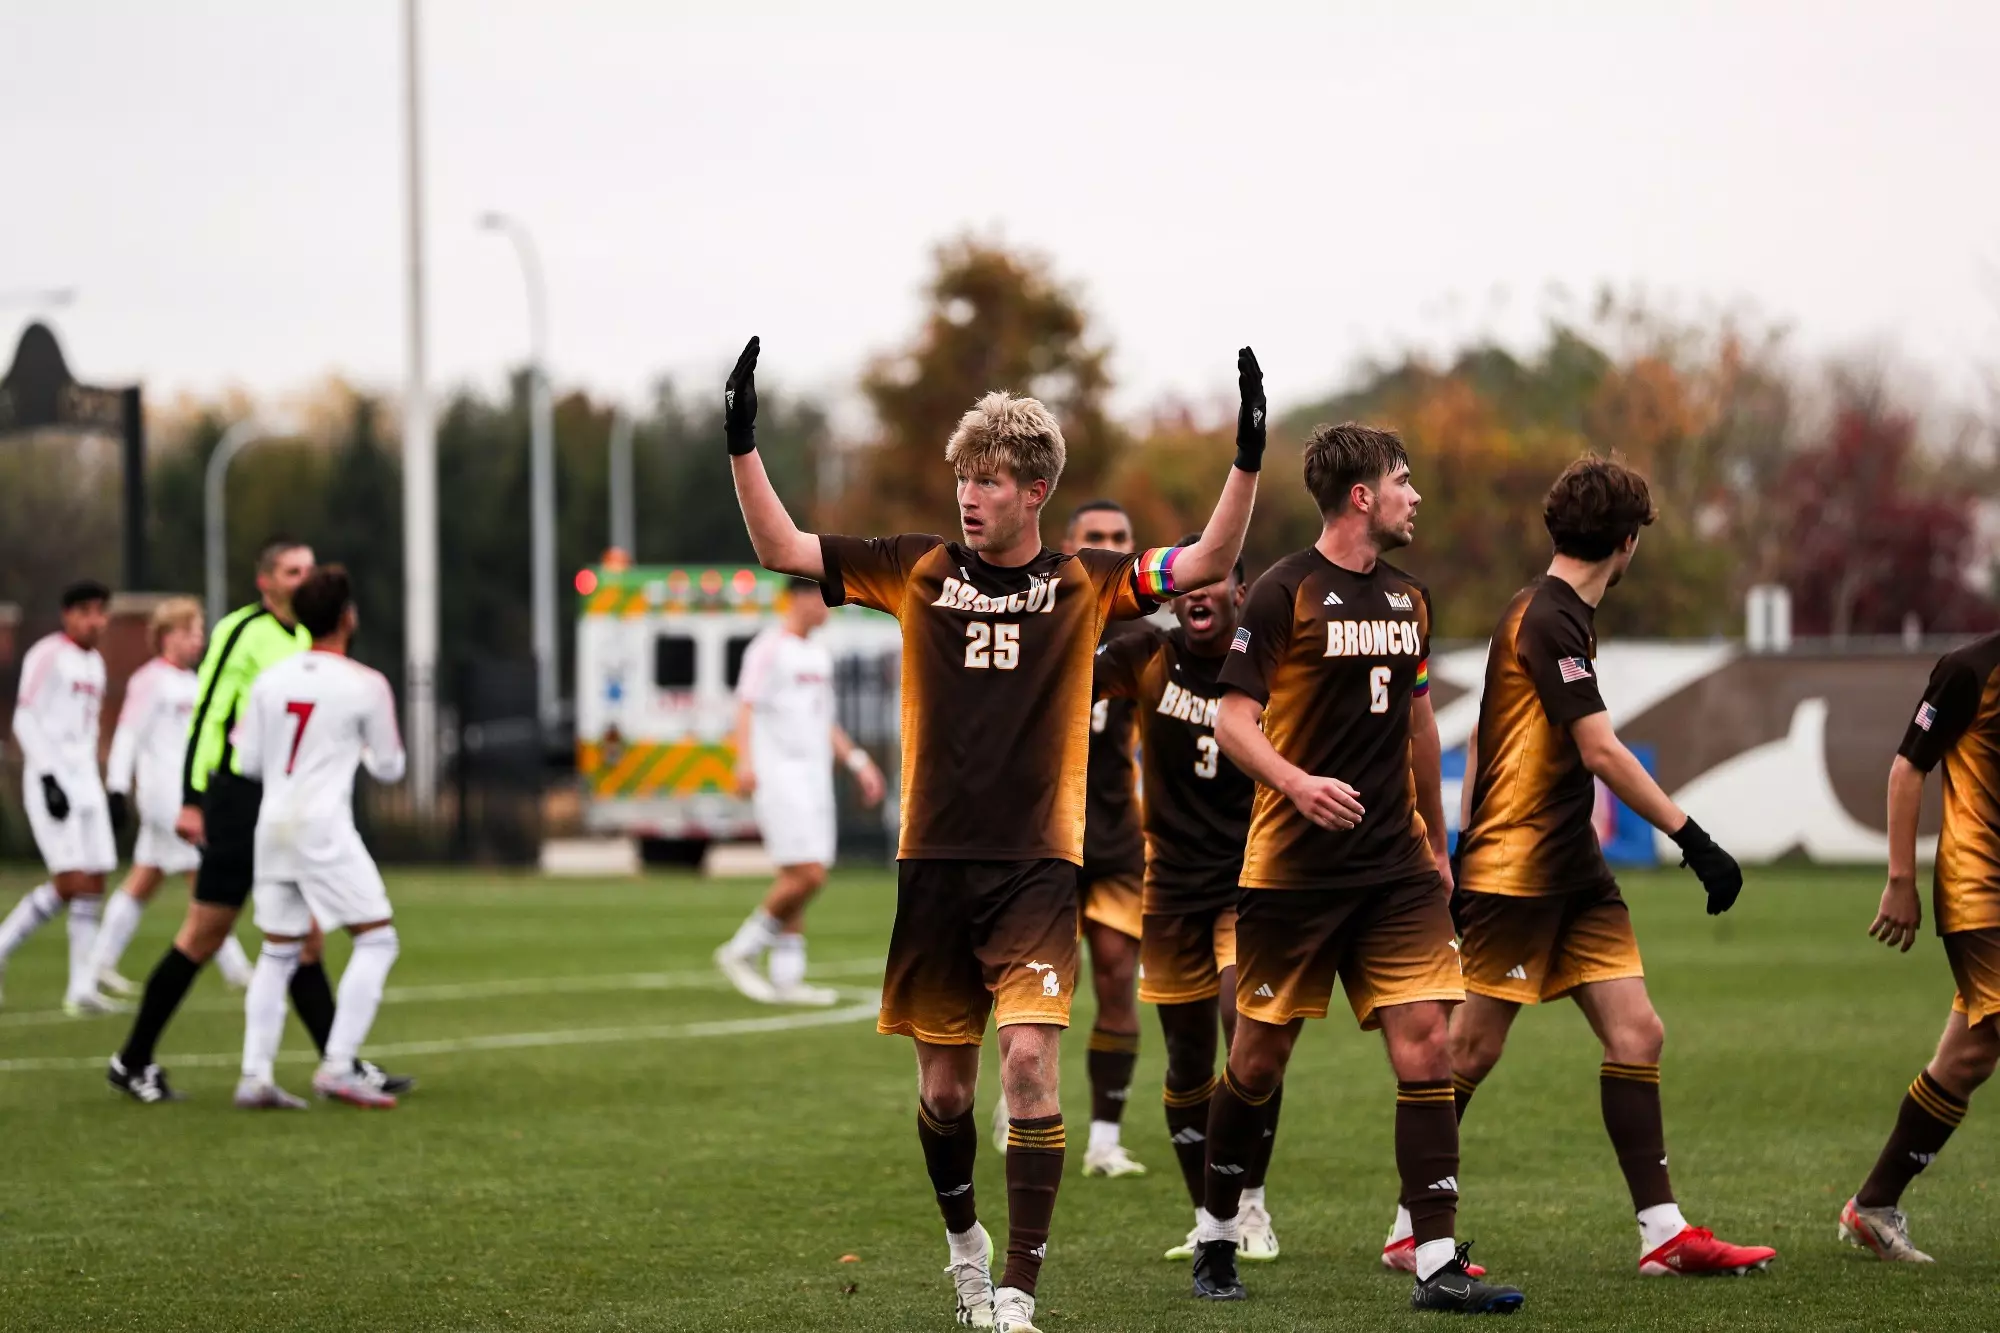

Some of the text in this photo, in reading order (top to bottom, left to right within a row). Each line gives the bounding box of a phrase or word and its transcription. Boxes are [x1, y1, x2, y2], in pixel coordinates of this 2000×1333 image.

[964, 621, 1020, 670] 25
[1323, 620, 1421, 658] BRONCOS
[1157, 680, 1221, 728] BRON
[1369, 665, 1392, 714] 6
[286, 702, 316, 775] 7
[1194, 735, 1218, 779] 3
